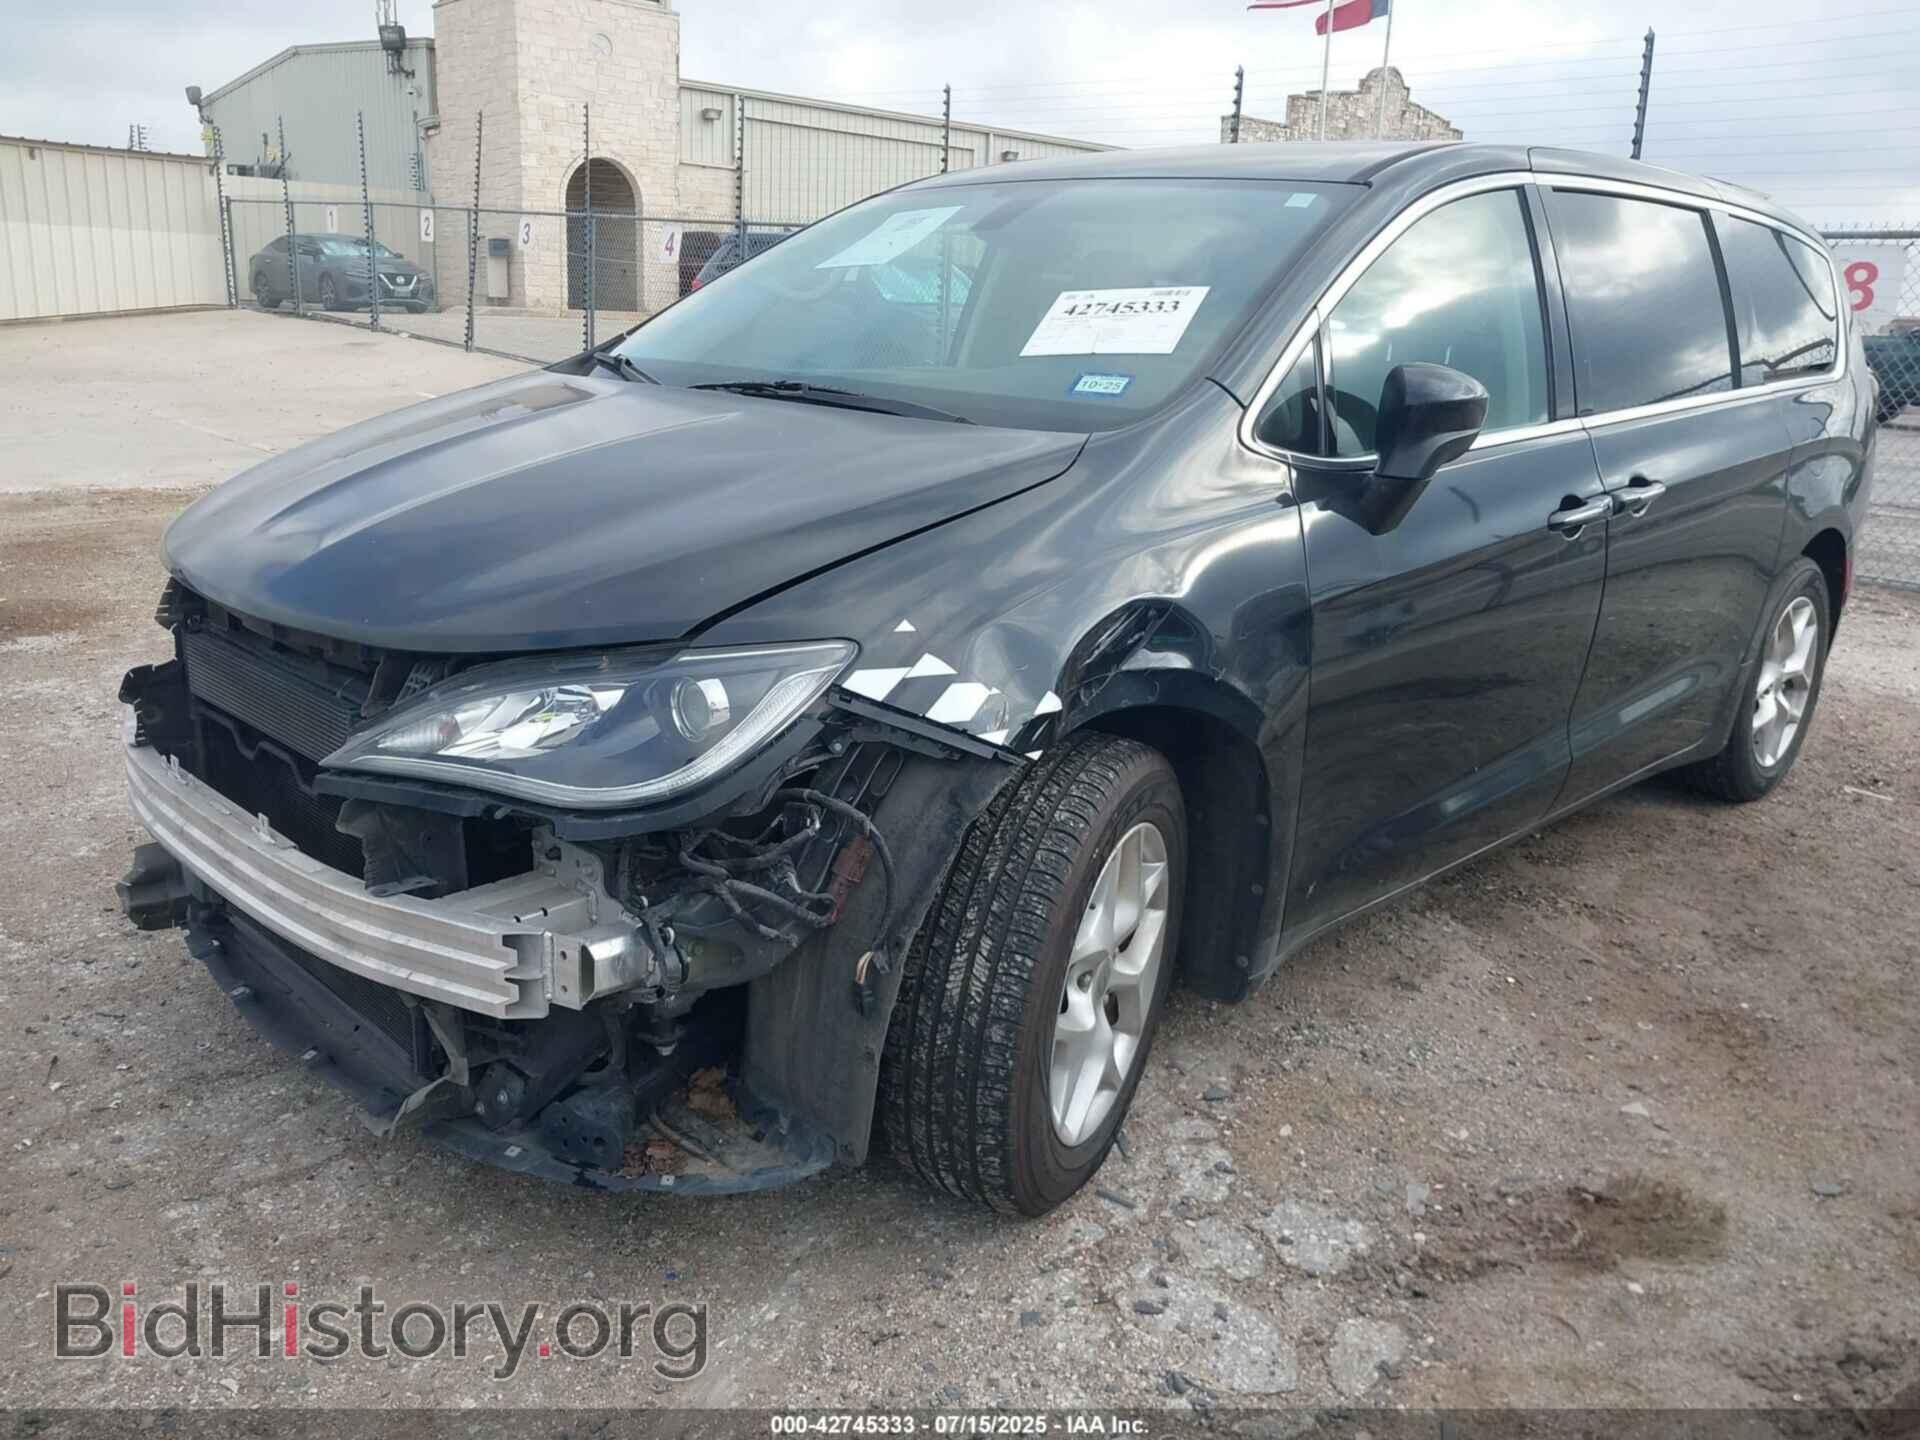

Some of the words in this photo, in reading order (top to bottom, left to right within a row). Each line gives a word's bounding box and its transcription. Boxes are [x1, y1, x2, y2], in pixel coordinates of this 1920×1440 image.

[423, 216, 432, 237] 2
[522, 223, 532, 245] 3
[664, 231, 676, 257] 4
[1844, 261, 1879, 312] 8
[1063, 300, 1181, 316] 42745333
